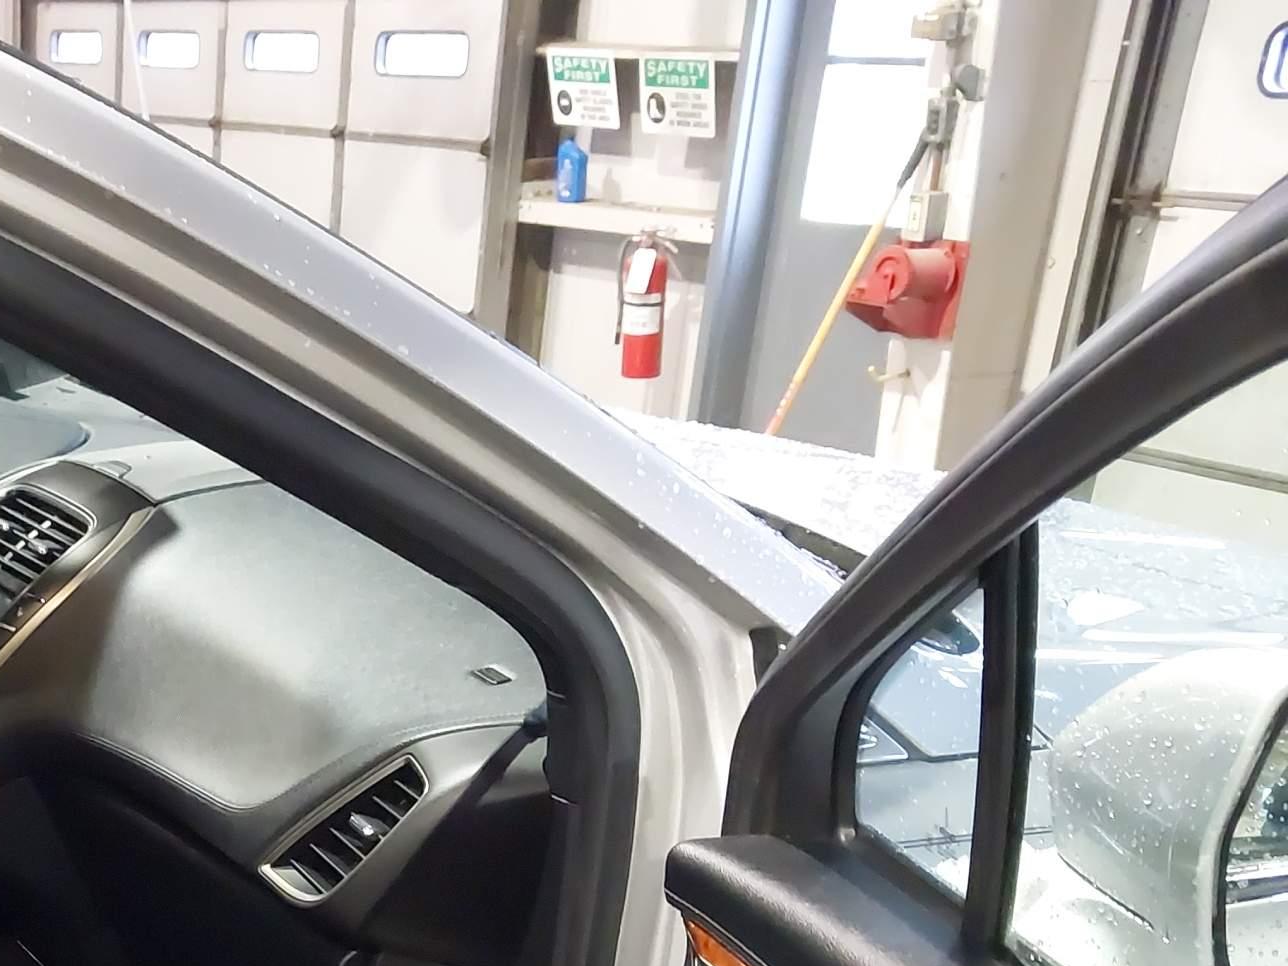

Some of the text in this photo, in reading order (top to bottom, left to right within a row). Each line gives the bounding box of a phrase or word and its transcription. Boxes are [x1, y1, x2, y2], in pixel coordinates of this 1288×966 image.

[553, 57, 609, 74] SAFETY
[646, 60, 708, 78] SAFETY
[563, 71, 601, 82] FIRST
[656, 74, 699, 87] FIRST
